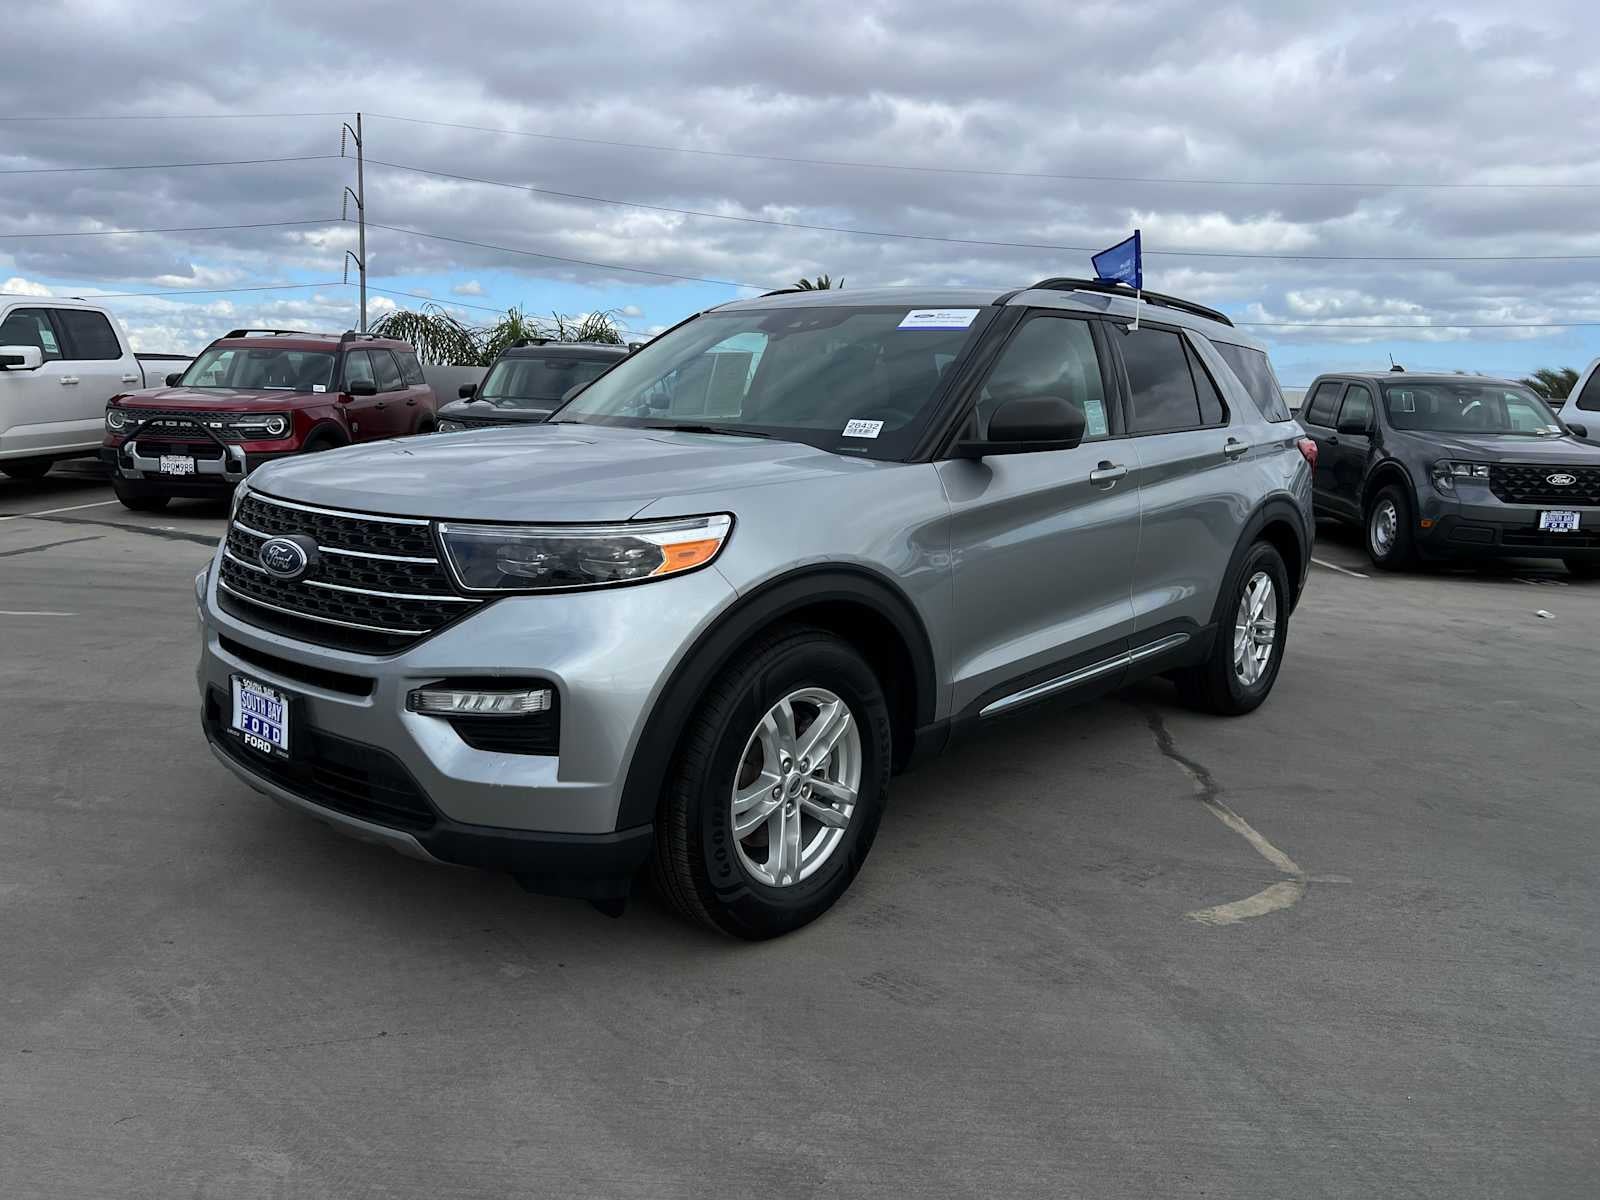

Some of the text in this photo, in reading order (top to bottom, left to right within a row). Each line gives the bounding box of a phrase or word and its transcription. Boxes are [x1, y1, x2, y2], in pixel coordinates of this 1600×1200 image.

[241, 691, 282, 722] SOUTH BAY
[242, 714, 280, 743] FORD
[244, 733, 271, 753] FORD
